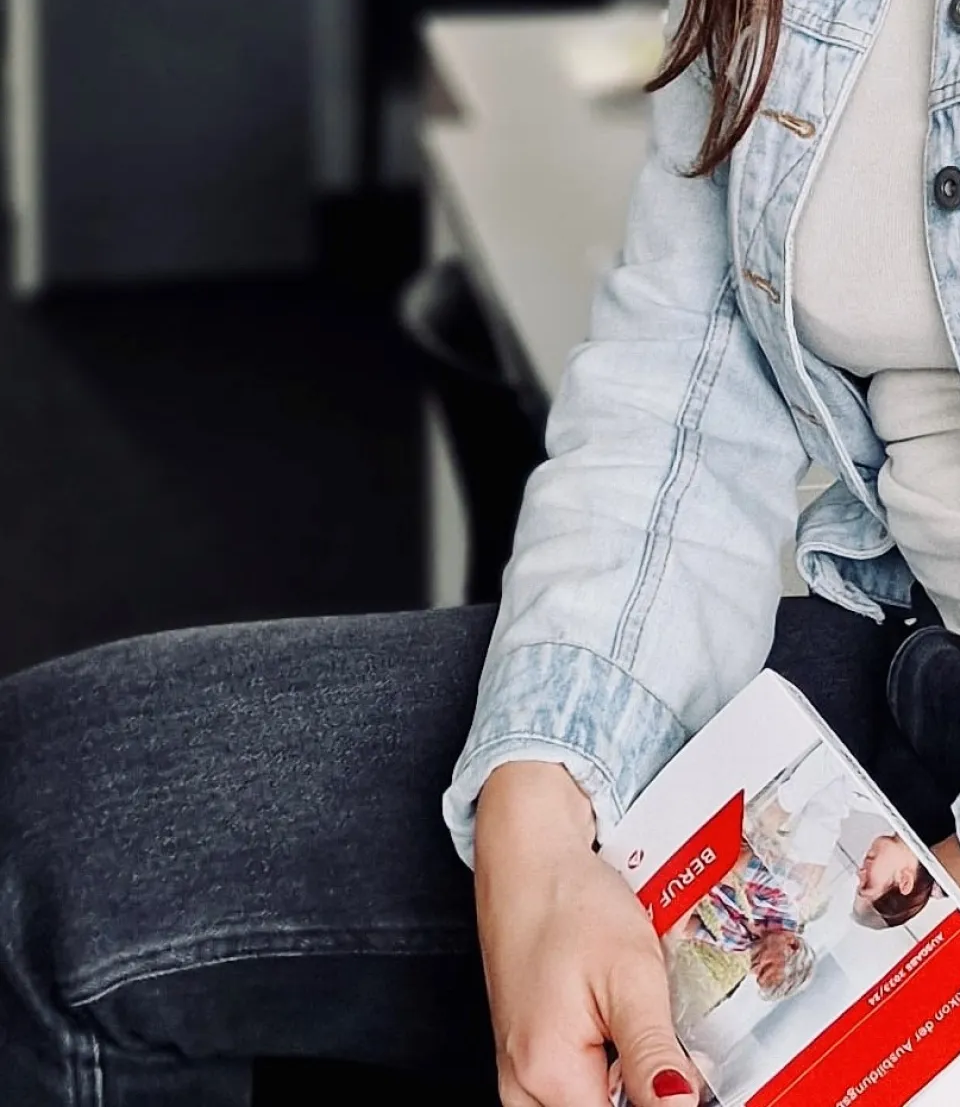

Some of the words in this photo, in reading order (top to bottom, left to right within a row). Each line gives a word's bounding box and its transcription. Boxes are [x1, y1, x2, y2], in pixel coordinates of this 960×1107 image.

[660, 847, 717, 908] BERUF
[905, 931, 945, 972] AUSGABE
[914, 1019, 935, 1042] der
